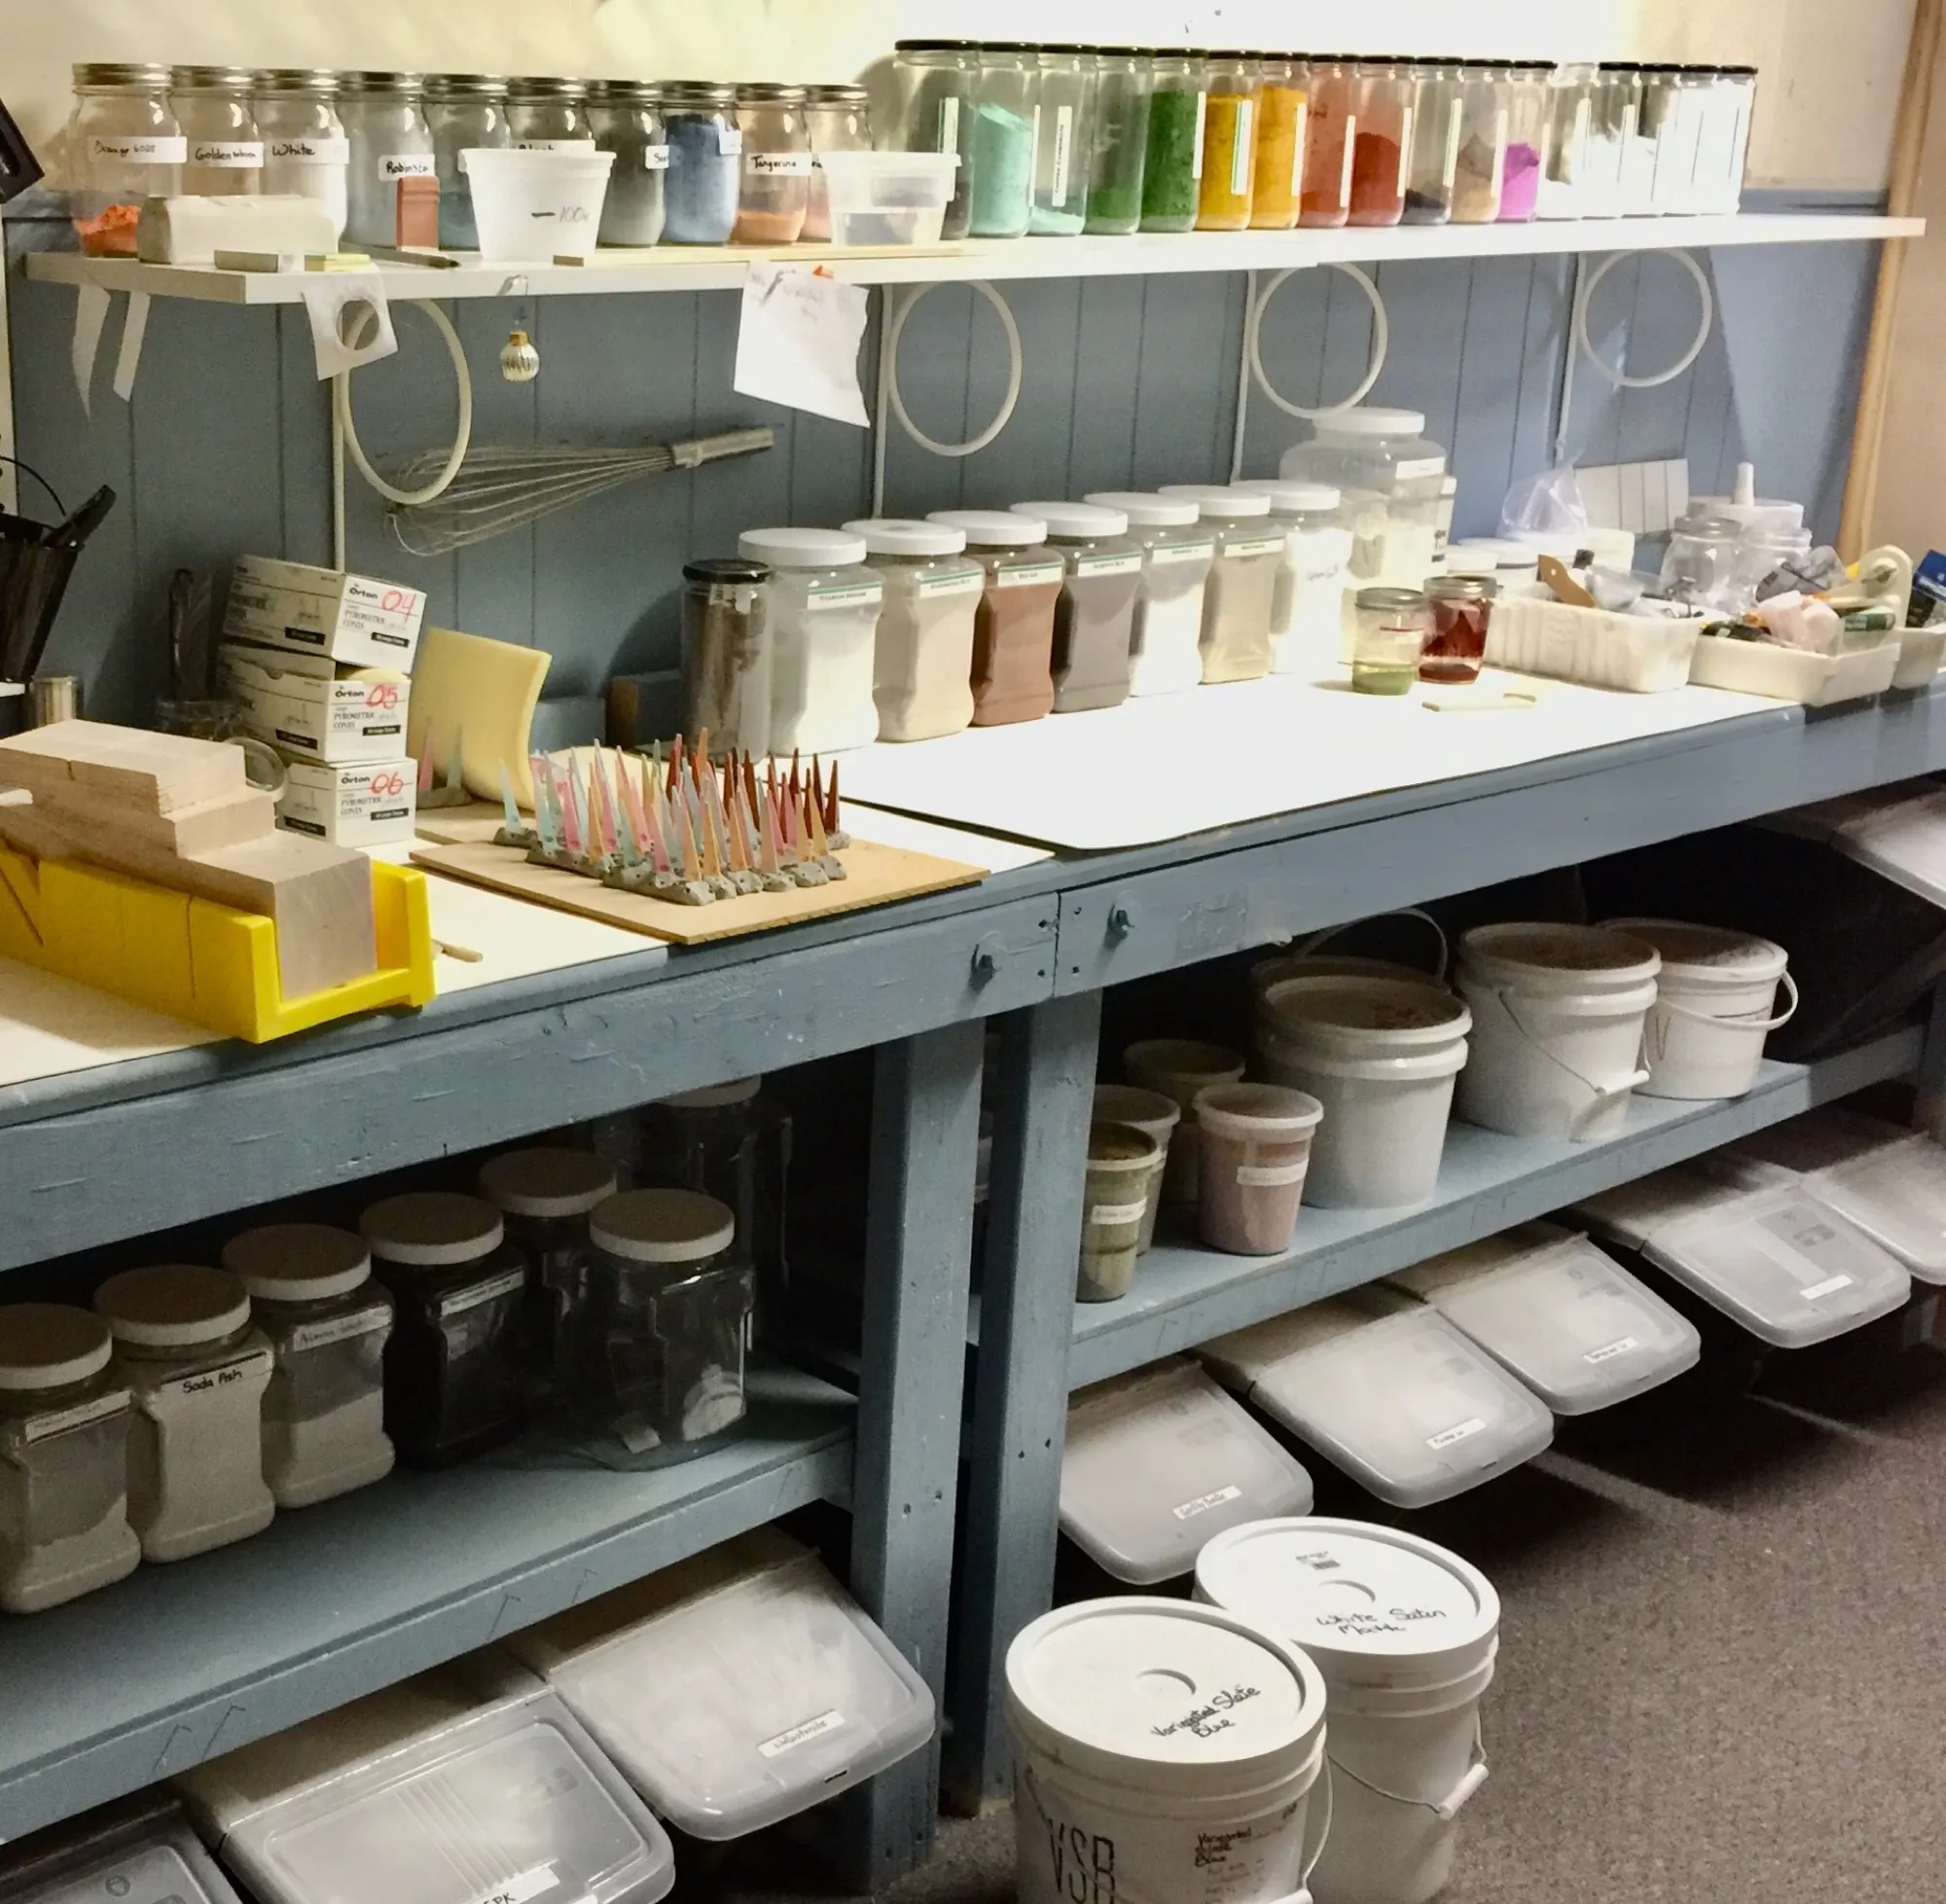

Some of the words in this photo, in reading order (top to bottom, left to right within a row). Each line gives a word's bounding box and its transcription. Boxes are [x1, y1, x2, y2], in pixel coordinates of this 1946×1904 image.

[195, 147, 232, 162] Golden
[271, 143, 315, 157] White
[348, 587, 378, 599] Orton
[381, 590, 417, 625] 04
[335, 689, 365, 699] Orton
[365, 684, 398, 710] 05
[341, 776, 371, 785] Orton
[371, 771, 405, 796] 06
[182, 1376, 215, 1394] Soda
[218, 1369, 243, 1385] Ash
[1315, 1612, 1379, 1626] White
[1388, 1606, 1448, 1622] Satin
[1211, 1684, 1262, 1710] Slate
[1191, 1718, 1236, 1739] Blue
